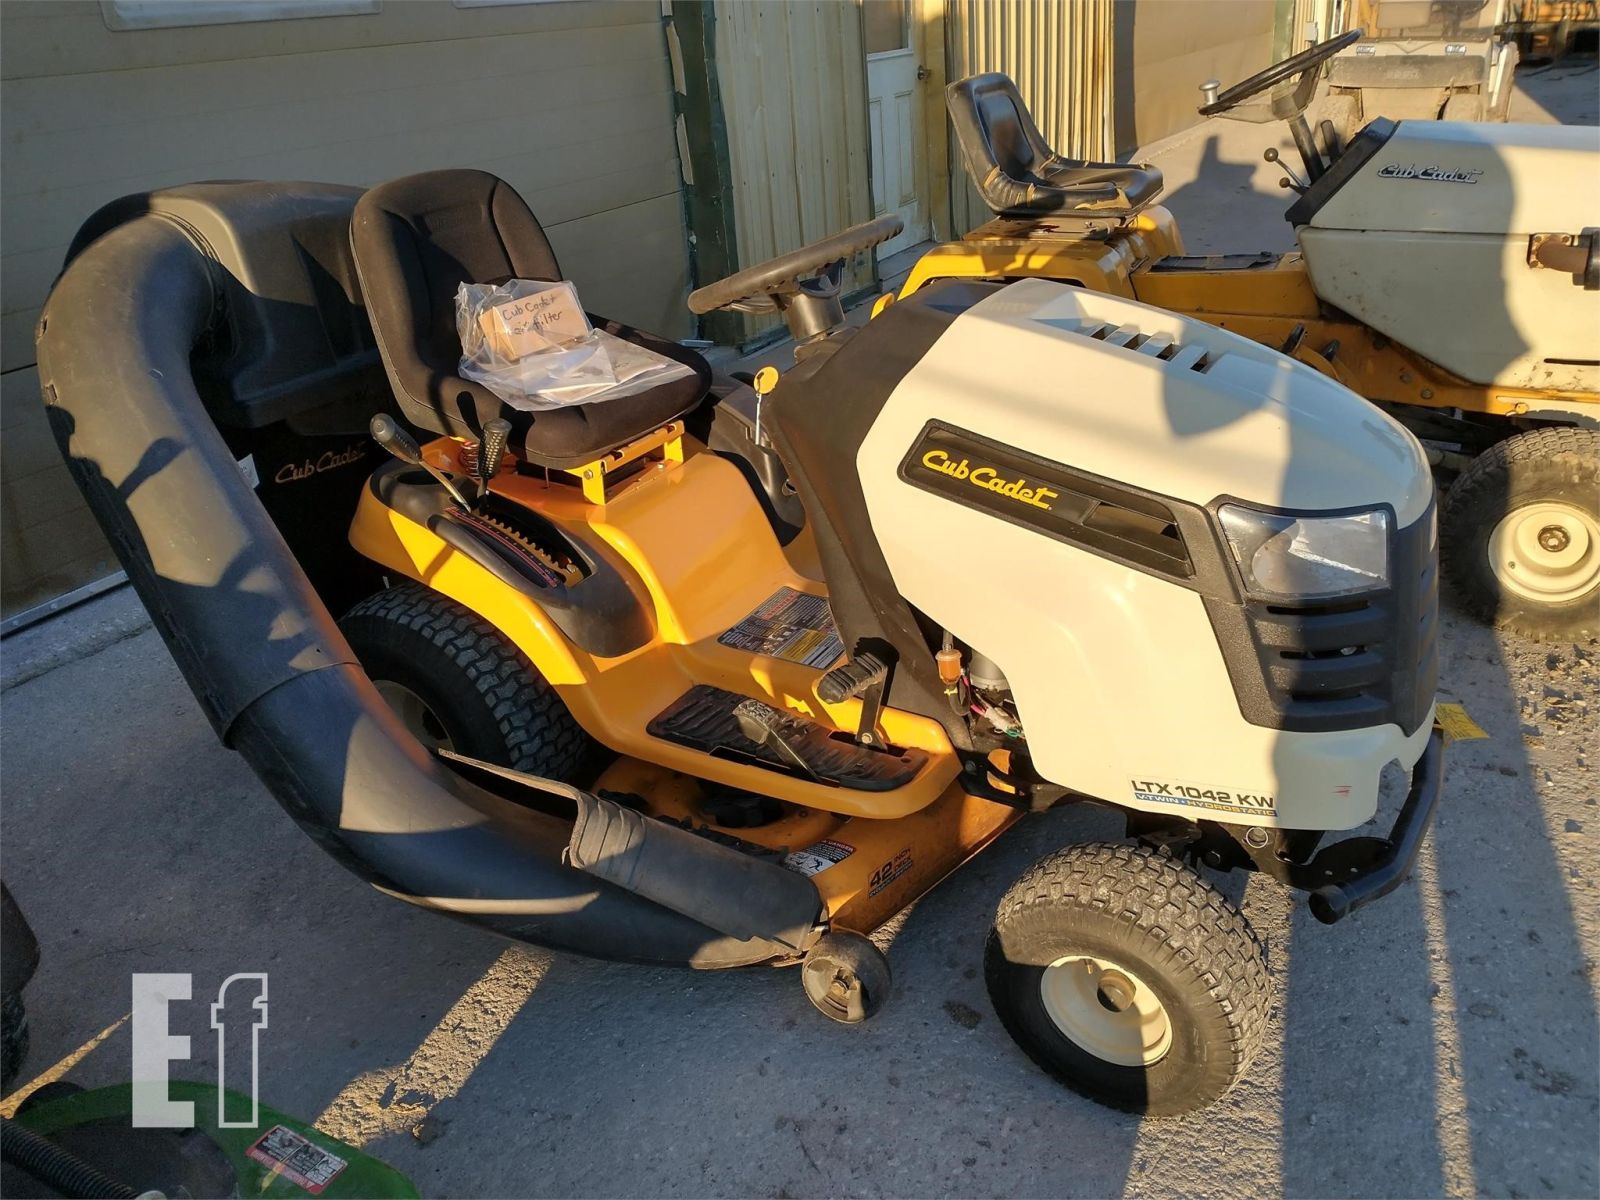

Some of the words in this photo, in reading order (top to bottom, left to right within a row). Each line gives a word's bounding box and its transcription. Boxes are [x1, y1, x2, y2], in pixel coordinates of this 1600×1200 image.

[1378, 163, 1415, 179] Cub
[1418, 165, 1484, 185] Cadet
[502, 304, 524, 321] Cub
[525, 294, 558, 313] Cadet
[275, 459, 315, 484] Cub
[922, 450, 969, 480] Cub
[969, 467, 1058, 510] Cadet
[1131, 779, 1173, 796] LTX
[1174, 785, 1233, 804] 1042
[1237, 793, 1275, 809] KW
[1187, 800, 1277, 817] HYDROSTATIC
[870, 860, 893, 888] 42
